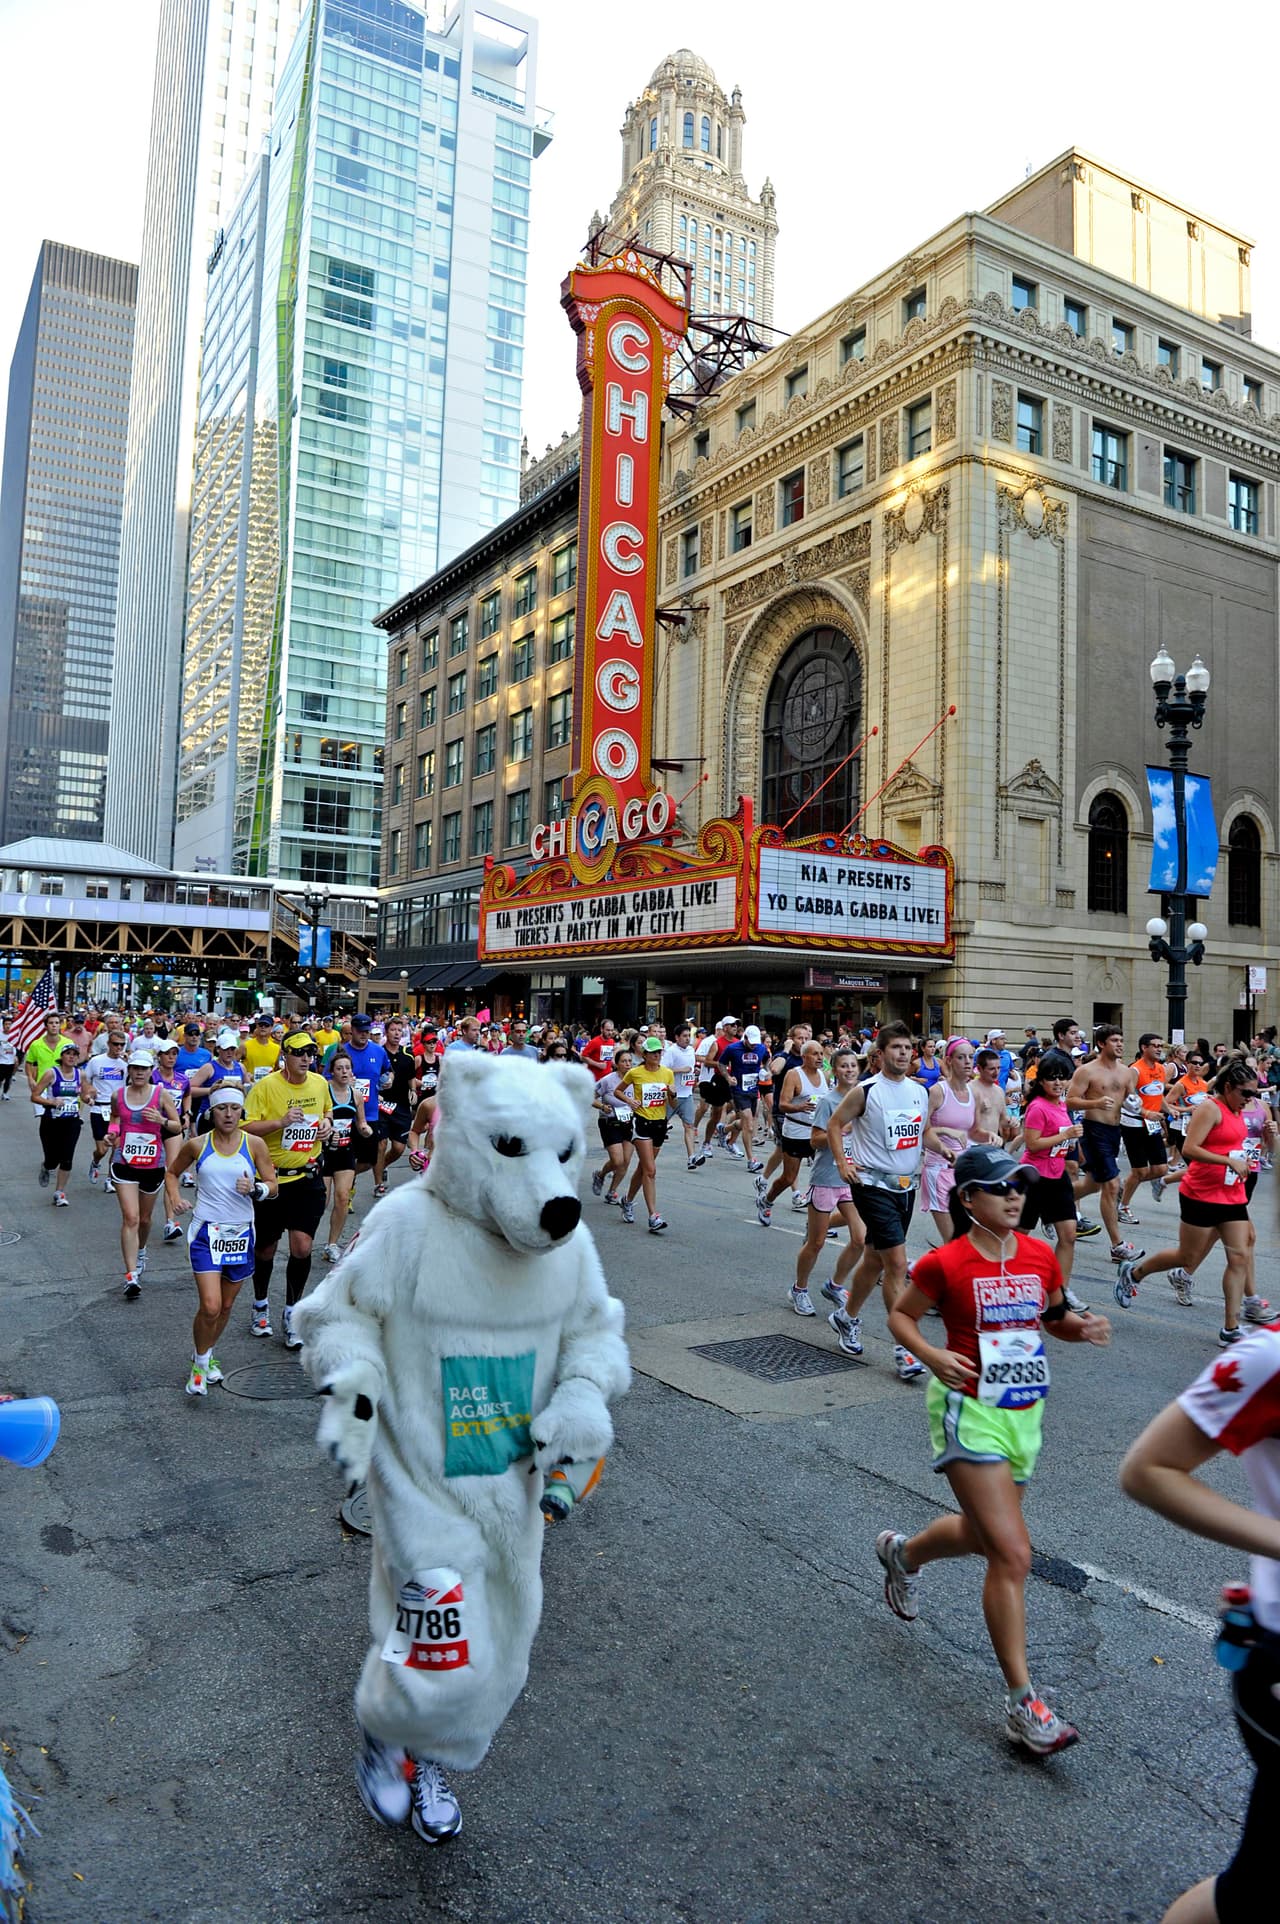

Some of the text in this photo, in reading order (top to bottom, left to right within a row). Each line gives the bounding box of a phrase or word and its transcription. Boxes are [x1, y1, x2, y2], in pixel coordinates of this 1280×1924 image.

[593, 320, 650, 783] CHICAGO
[531, 792, 670, 860] CHICAGO
[801, 864, 911, 891] KIA PRESENTS
[496, 881, 718, 929] KIA PRESENTS YO GABBA GABBA LIVE!
[767, 893, 939, 924] YO GABBA GABBA LIVE!
[515, 910, 685, 946] THERE'S A PARTY IN MY CITY!
[644, 1093, 665, 1101] 25224
[285, 1129, 317, 1141] 28087
[888, 1124, 920, 1138] 14506
[125, 1144, 155, 1155] 38176
[212, 1239, 246, 1252] 40558
[448, 1387, 488, 1401] RACE
[450, 1402, 512, 1419] AGAINST
